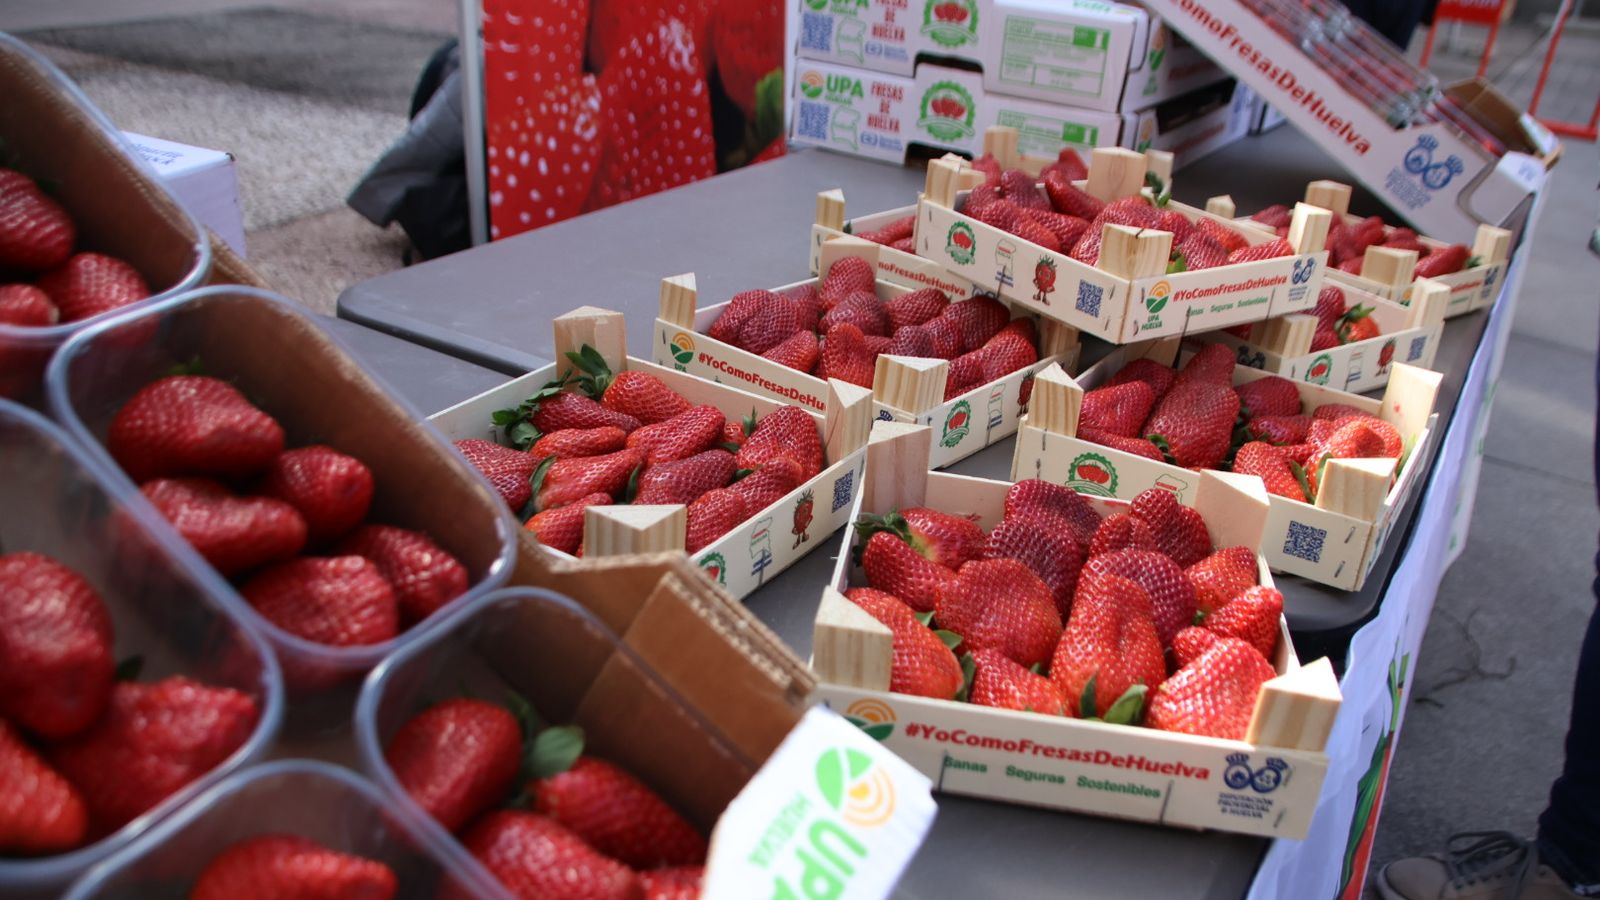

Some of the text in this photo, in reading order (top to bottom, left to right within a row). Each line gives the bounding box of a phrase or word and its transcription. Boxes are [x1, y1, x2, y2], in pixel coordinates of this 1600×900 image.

[826, 74, 865, 98] UPA
[871, 81, 904, 101] FRESAS
[1173, 275, 1288, 302] #YoComoFresasDeHuelva
[698, 352, 827, 411] #YoComoFresasDeHu
[905, 723, 1211, 781] #YoComoFresasDeHuelva
[1005, 765, 1066, 786] Seguras
[1077, 775, 1161, 799] Sostenibles
